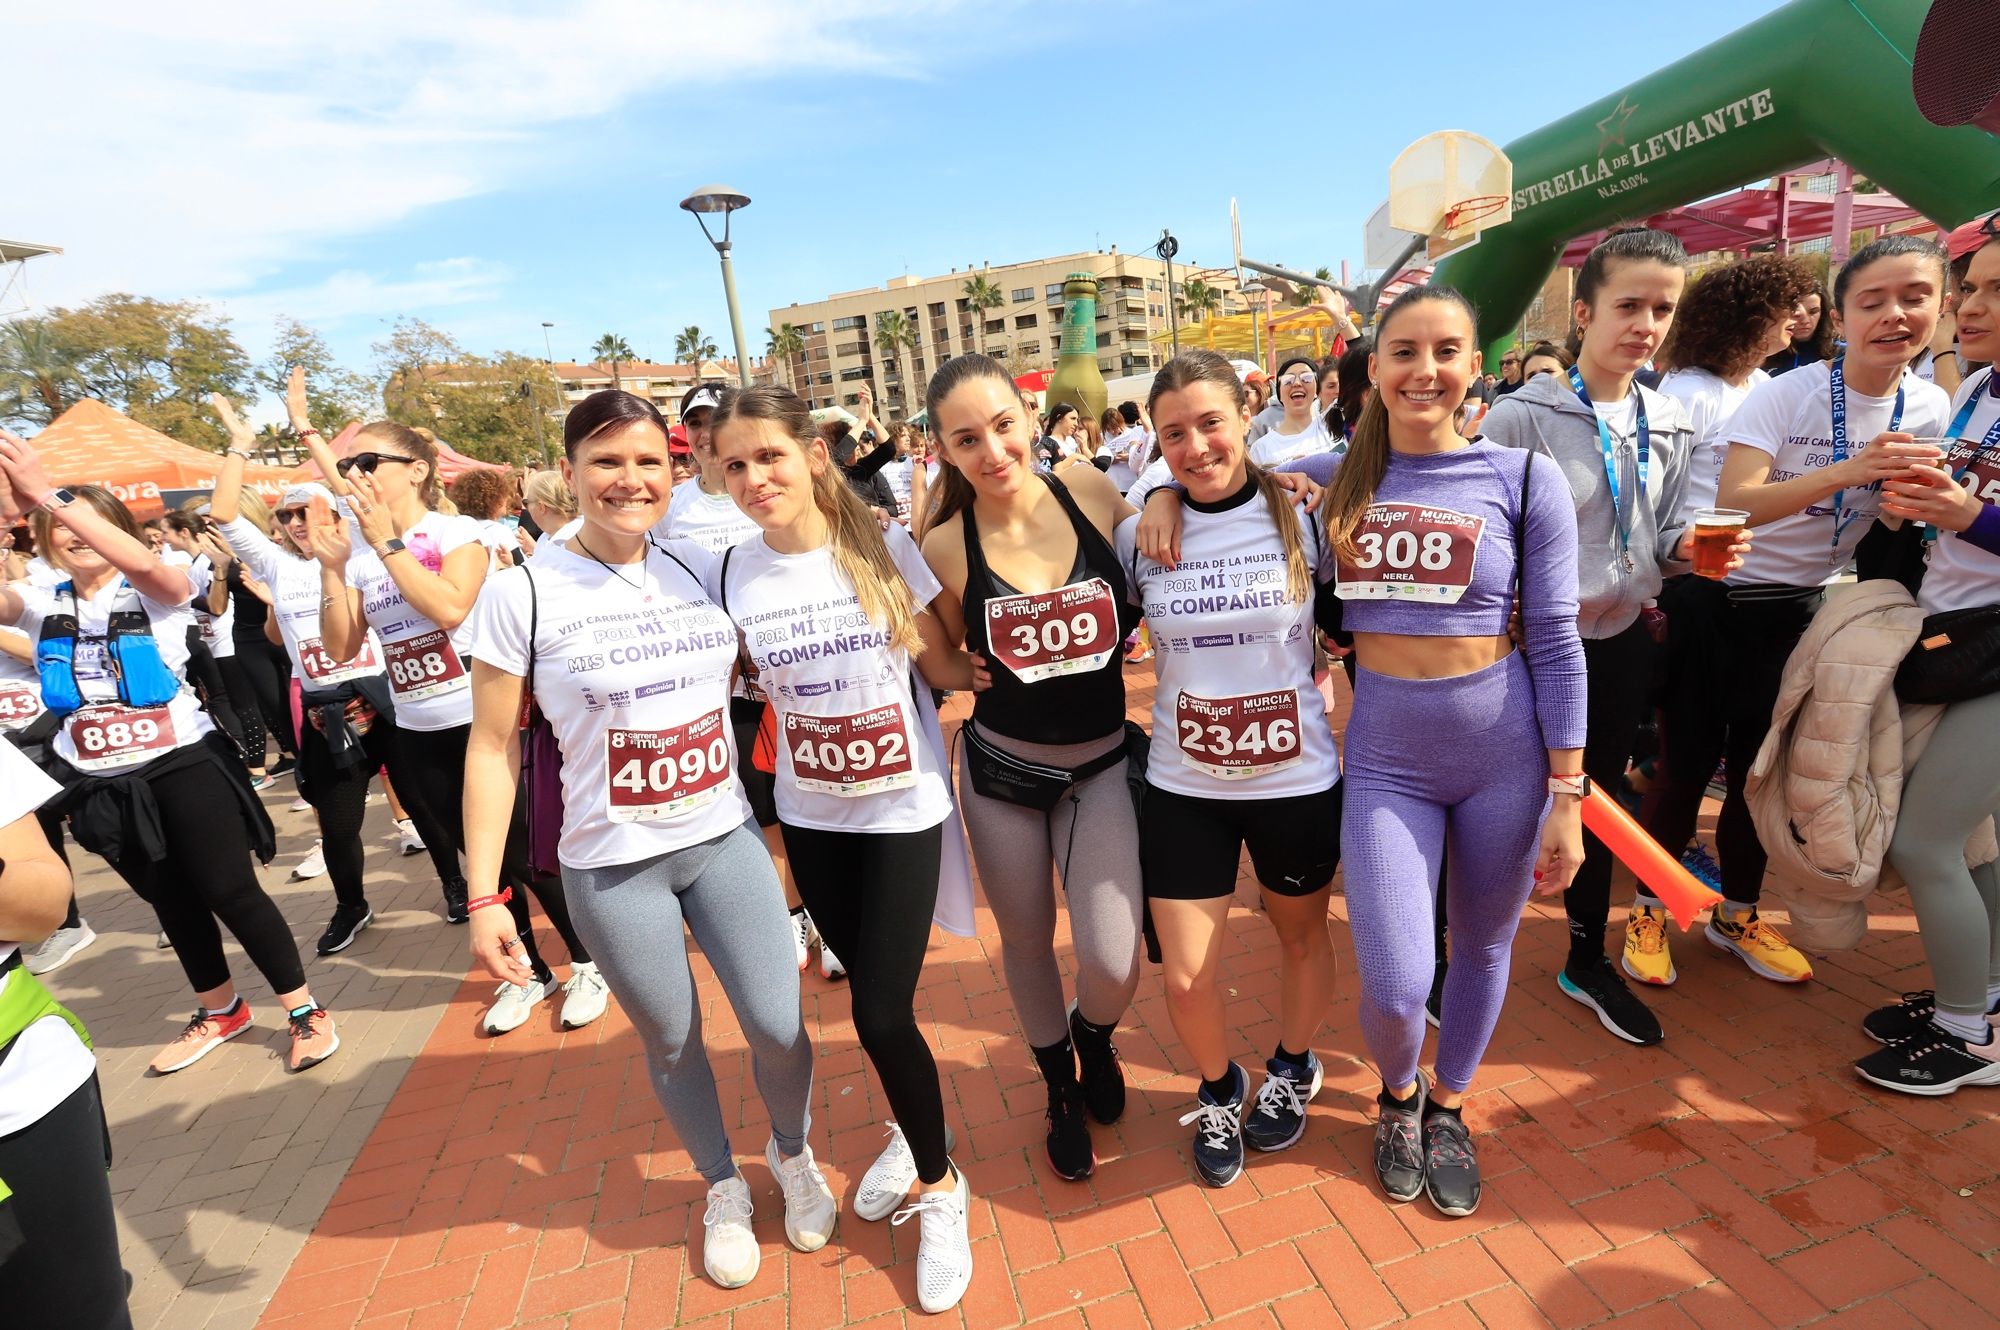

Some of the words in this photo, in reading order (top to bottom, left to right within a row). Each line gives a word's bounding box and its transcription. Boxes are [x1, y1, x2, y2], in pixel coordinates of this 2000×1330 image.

[1612, 154, 1630, 170] DE
[1630, 88, 1775, 167] LEVANTE
[1831, 369, 1845, 418] CHANGE
[1788, 435, 1809, 445] VIII
[1834, 419, 1846, 455] YOUR
[1366, 507, 1387, 515] arrera
[1366, 511, 1409, 529] mujer
[1420, 509, 1476, 526] MURCIA
[713, 534, 729, 546] MÍ
[1354, 530, 1453, 571] 308
[1146, 566, 1162, 577] VIII
[1164, 561, 1209, 573] CRRERA
[1212, 558, 1225, 568] DE
[1228, 557, 1242, 567] LA
[1245, 553, 1278, 565] MUJER
[1164, 578, 1198, 594] POR
[1200, 569, 1226, 590] MÍ
[1229, 573, 1242, 588] Y
[1246, 569, 1282, 585] POR
[1382, 572, 1415, 581] NEREA
[1004, 599, 1030, 607] carrera
[1061, 584, 1105, 603] MURCIA
[1075, 595, 1095, 606] MARZO
[1170, 588, 1287, 615] COMPAÑER
[558, 620, 584, 636] VIII
[586, 611, 640, 625] CARRERA
[642, 608, 657, 618] DE
[661, 606, 675, 616] LA
[676, 599, 707, 612] MUJER
[754, 608, 798, 623] CARRERA
[801, 604, 814, 615] DE
[817, 600, 830, 611] LA
[1013, 601, 1053, 620] mujer
[593, 625, 637, 644] POR
[636, 617, 667, 637] MÍ
[667, 617, 681, 632] Y
[682, 610, 720, 629] POR
[756, 627, 788, 647] POR
[791, 615, 817, 638] MÍ
[818, 617, 832, 633] Y
[834, 612, 870, 631] POR
[1010, 612, 1098, 658] 309
[409, 632, 445, 648] MURCIA
[767, 631, 892, 668] COMPAÑERAS
[391, 652, 447, 685] 888
[567, 653, 604, 674] MIS
[1188, 697, 1211, 707] carrera
[1243, 694, 1291, 709] MURCIA
[798, 716, 820, 725] carrera
[851, 708, 898, 727] MURCIA
[1195, 704, 1234, 722] mujer
[82, 718, 159, 751] 889
[688, 713, 720, 736] MURCIA
[806, 723, 842, 739] mujer
[866, 721, 886, 730] MARZO
[637, 734, 680, 755] mujer
[1180, 718, 1297, 756] 2346
[794, 732, 907, 772] 4092
[612, 737, 728, 794] 4090
[673, 789, 686, 799] ELI
